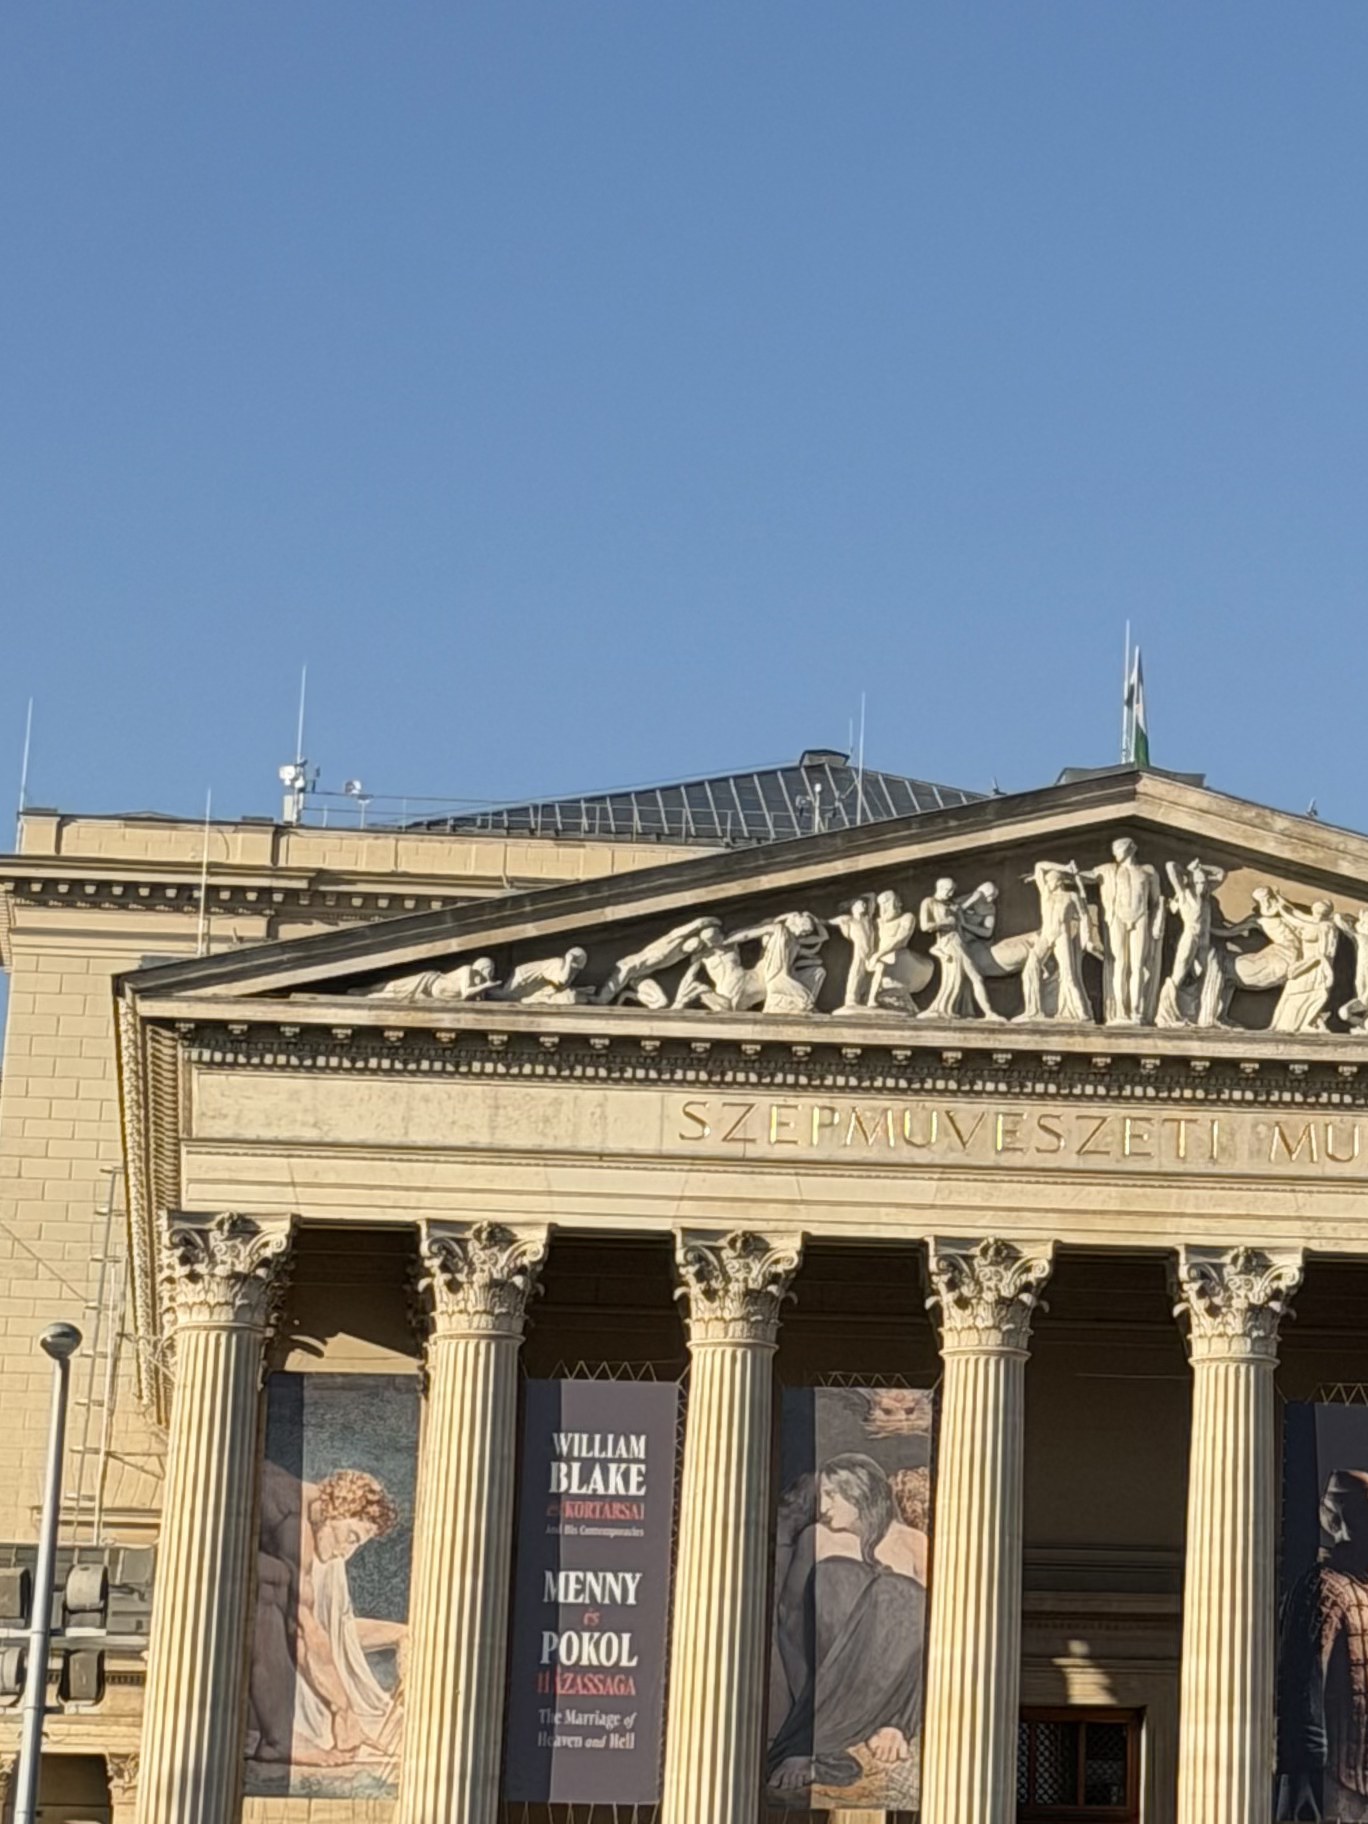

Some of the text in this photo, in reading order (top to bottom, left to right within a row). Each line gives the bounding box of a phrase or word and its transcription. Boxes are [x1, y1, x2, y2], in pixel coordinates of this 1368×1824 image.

[552, 1432, 647, 1459] WILLIAM
[548, 1461, 647, 1496] BLAKE
[542, 1569, 643, 1606] MENNY
[539, 1629, 639, 1668] POKOL
[538, 1707, 638, 1731] The Marriage of
[537, 1730, 583, 1749] Heaven
[608, 1731, 636, 1750] Hell
